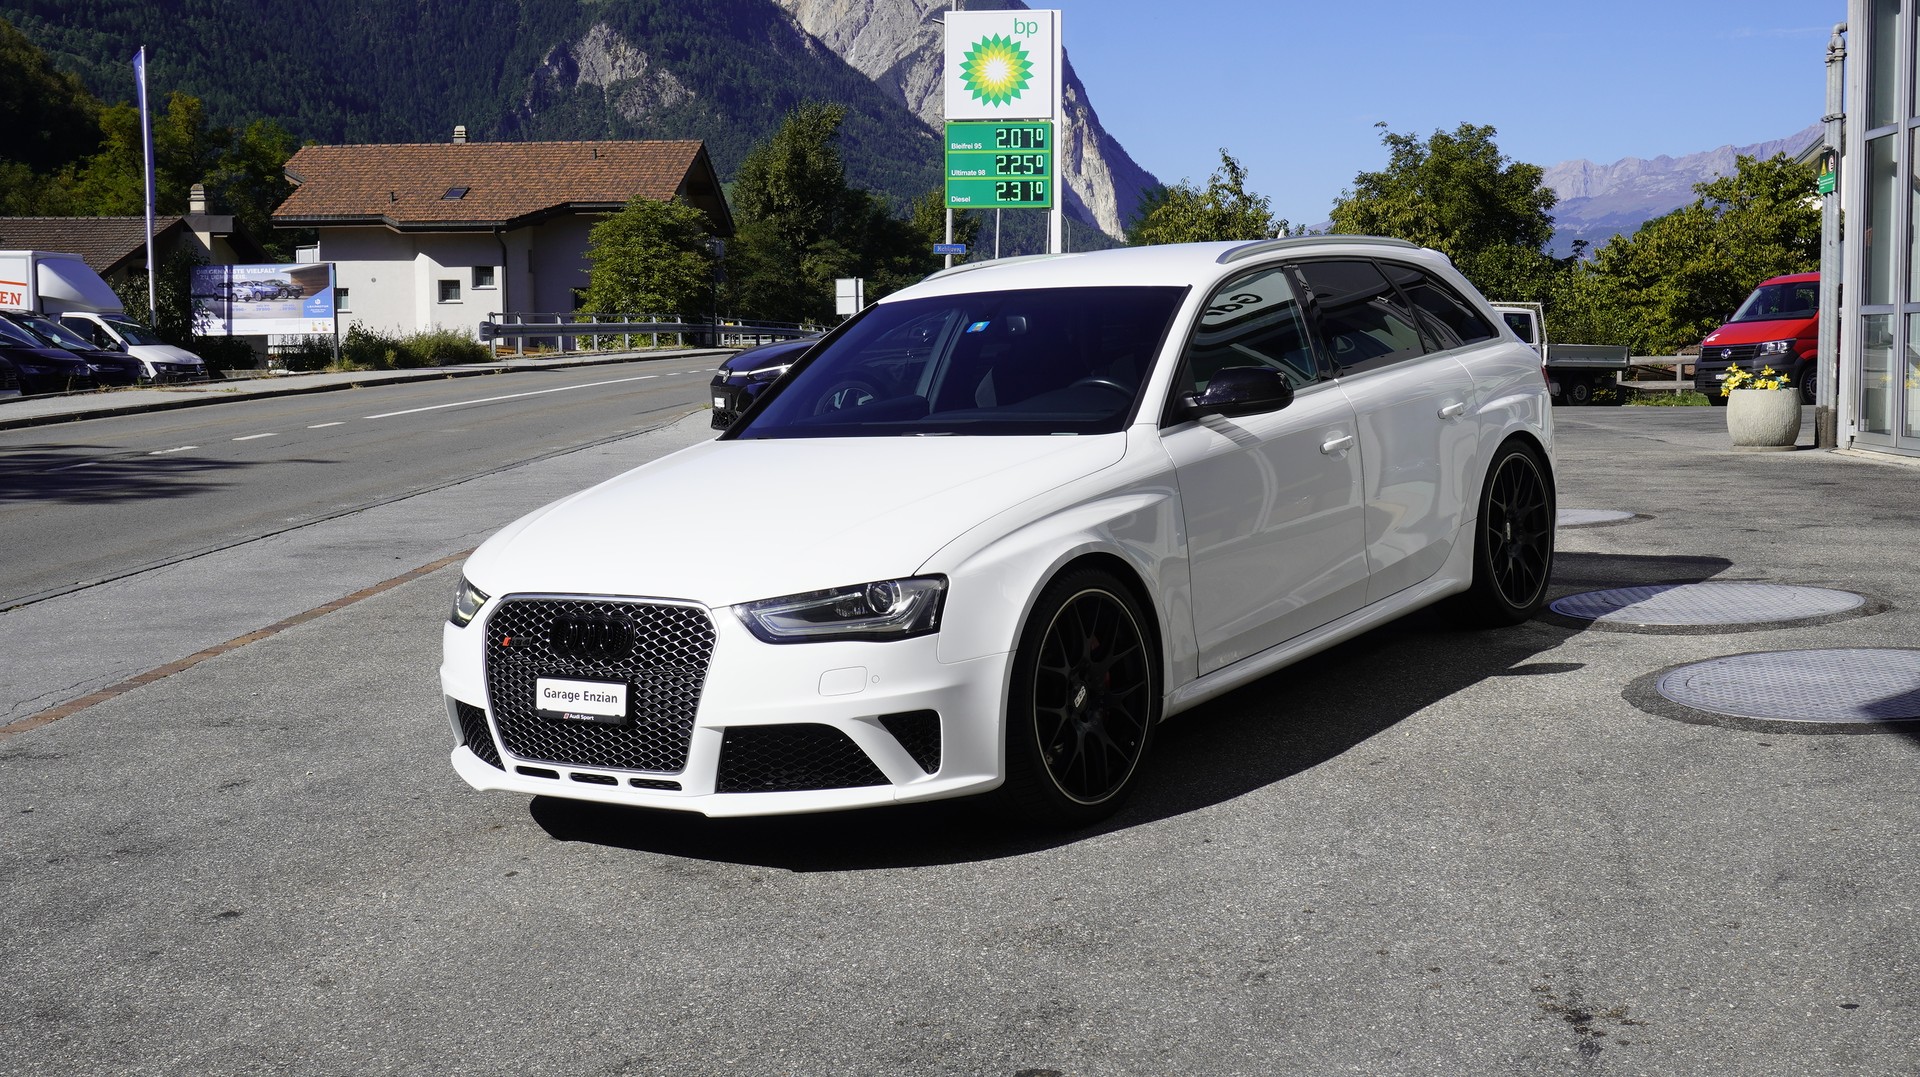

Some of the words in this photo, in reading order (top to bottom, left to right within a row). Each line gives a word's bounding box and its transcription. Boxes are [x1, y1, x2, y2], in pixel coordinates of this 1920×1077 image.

[1014, 17, 1038, 38] bp
[543, 687, 581, 703] Garage
[583, 690, 618, 704] Enzian
